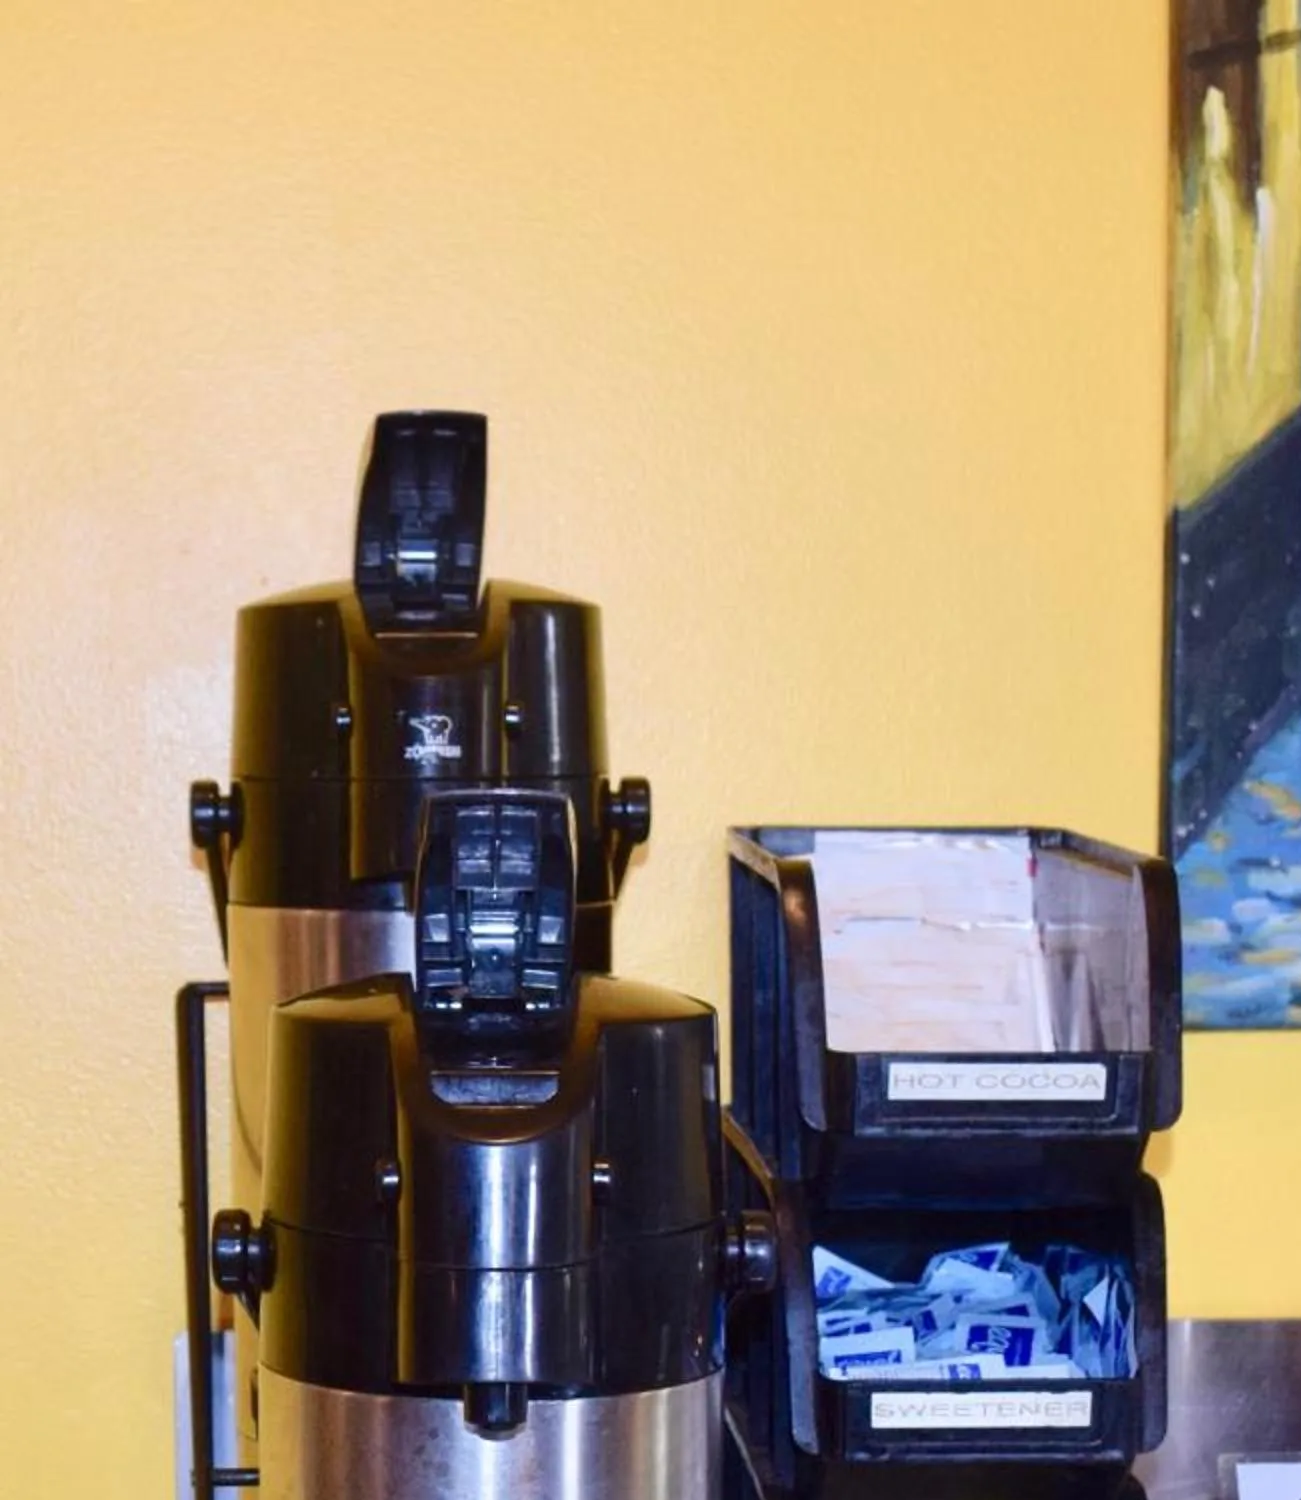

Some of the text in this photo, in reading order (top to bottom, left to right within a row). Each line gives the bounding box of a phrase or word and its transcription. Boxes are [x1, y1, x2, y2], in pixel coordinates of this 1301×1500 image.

[893, 1072, 1101, 1090] HOT COCOA
[874, 1401, 1088, 1418] SWEETENER
